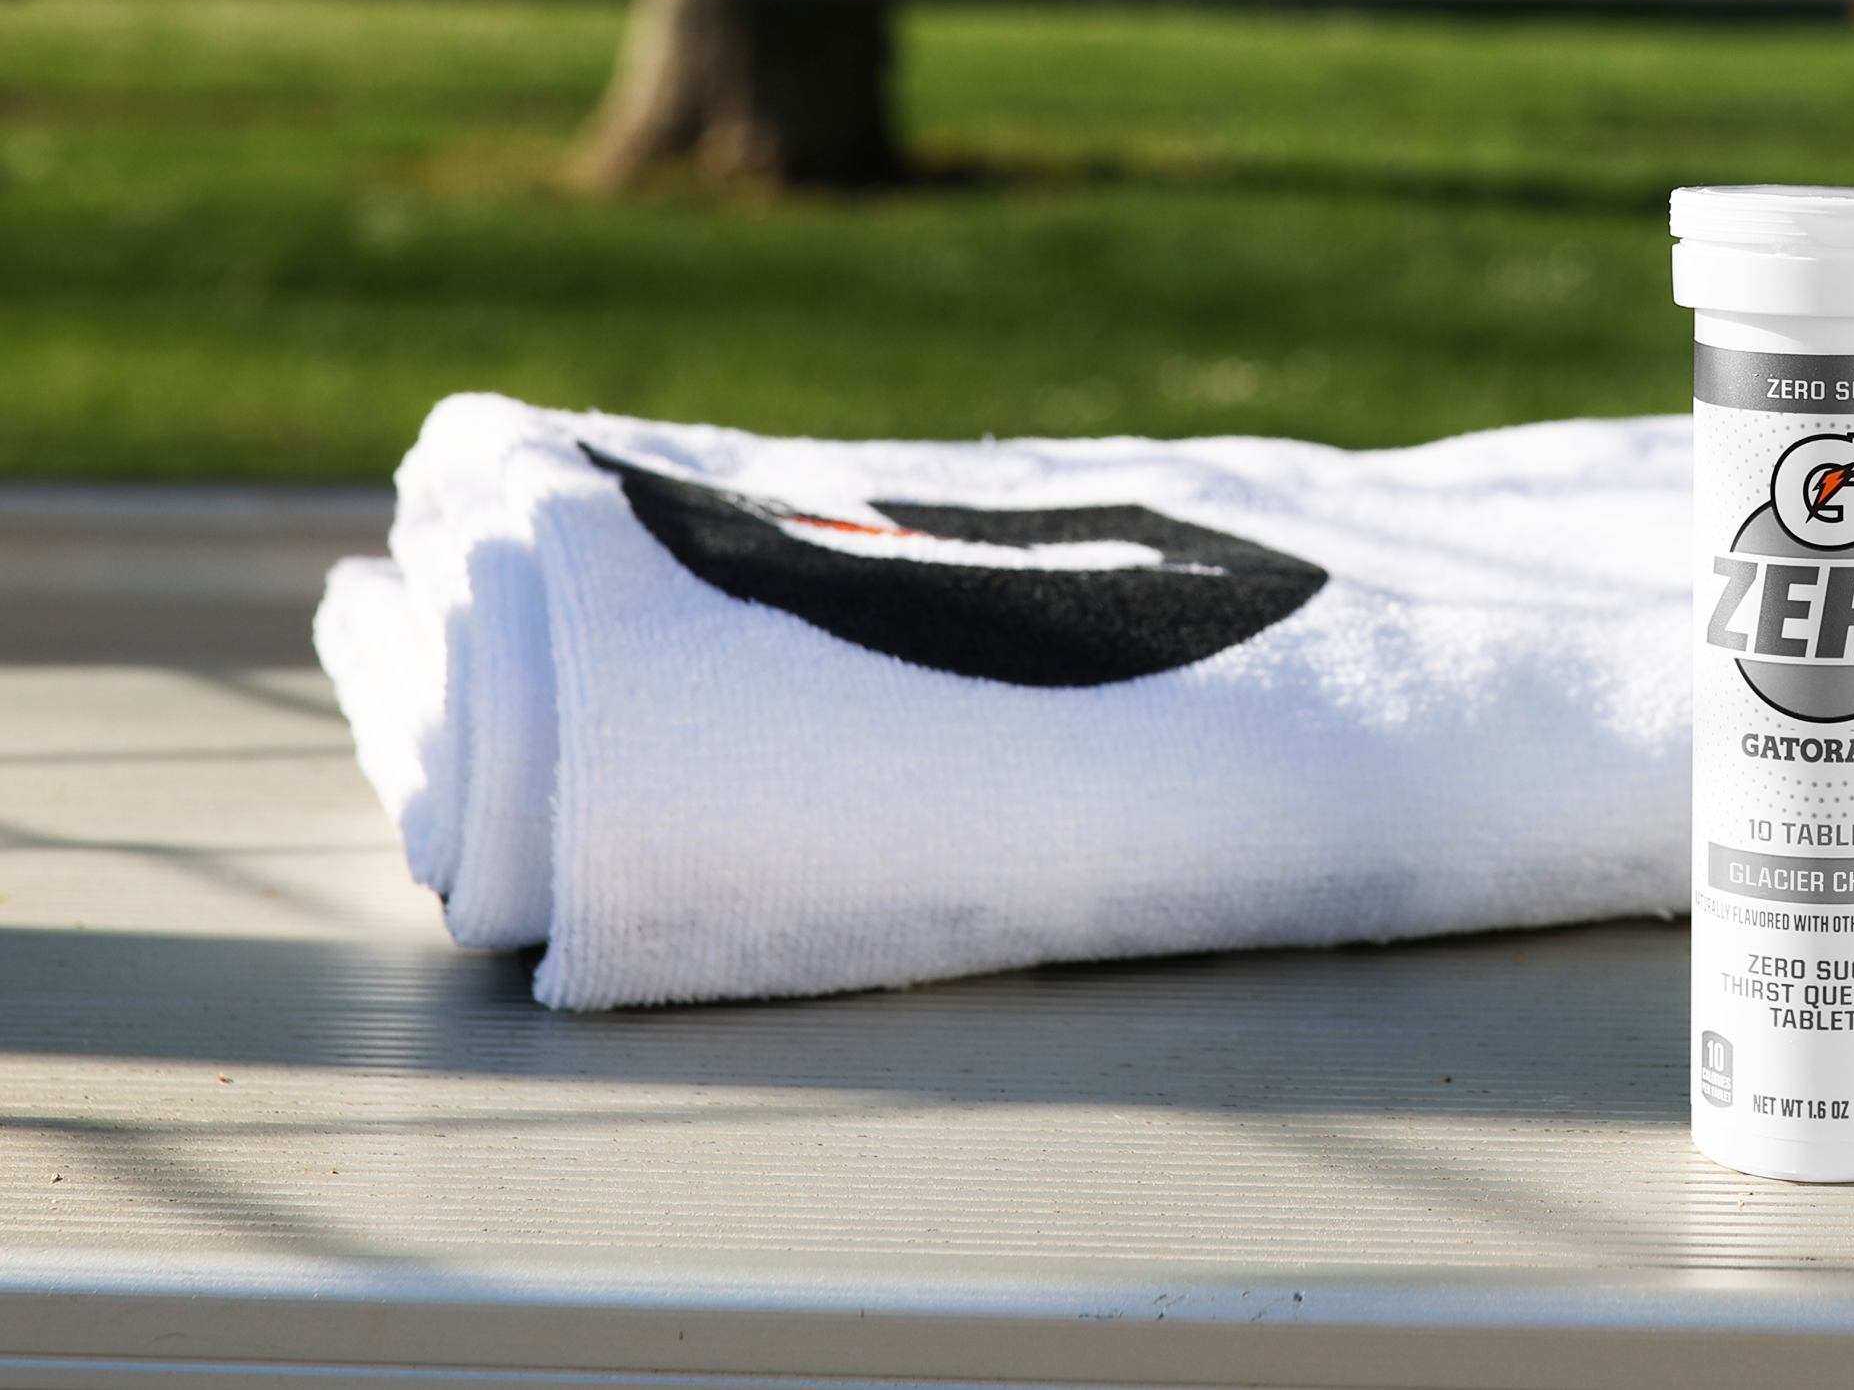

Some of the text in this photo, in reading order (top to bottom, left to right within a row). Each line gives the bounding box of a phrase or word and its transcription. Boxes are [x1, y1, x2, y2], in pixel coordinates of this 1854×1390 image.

[1766, 378, 1826, 400] ZERO
[1749, 818, 1773, 842] 10
[1728, 861, 1825, 893] GLACIER
[1733, 905, 1790, 931] FLAVORED
[1794, 914, 1829, 933] WITH
[1747, 953, 1806, 980] ZERO
[1721, 972, 1794, 1004] THIRST
[1707, 1039, 1725, 1072] 10
[1702, 1066, 1732, 1091] CALORIES
[1753, 1093, 1776, 1115] NET
[1781, 1098, 1804, 1118] WT
[1807, 1100, 1826, 1119] 1.6
[1831, 1100, 1849, 1119] OZ
